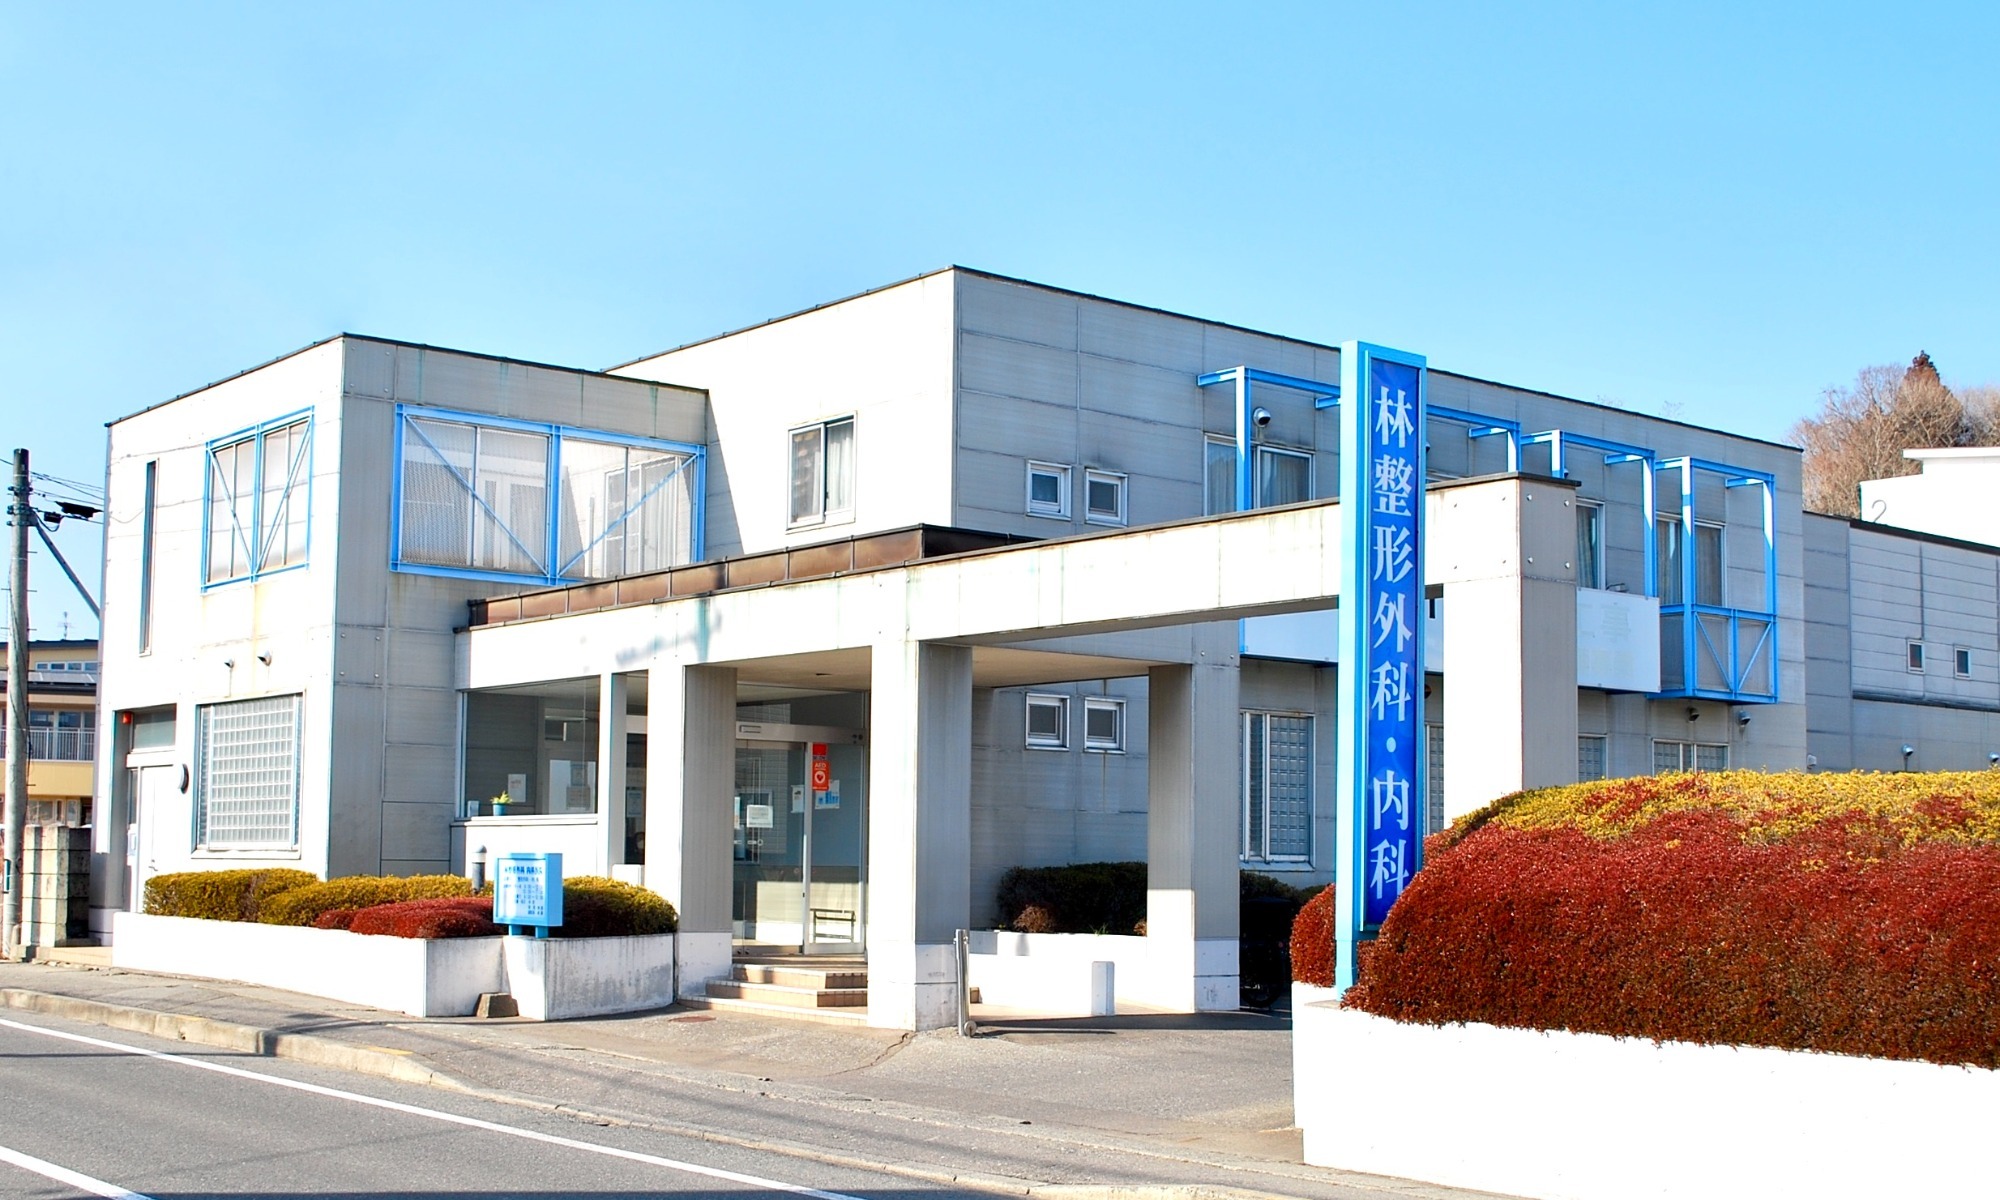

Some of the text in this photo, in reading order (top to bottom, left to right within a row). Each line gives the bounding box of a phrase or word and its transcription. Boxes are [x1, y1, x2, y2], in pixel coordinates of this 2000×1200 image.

[1370, 385, 1414, 899] 林整形外科・内科
